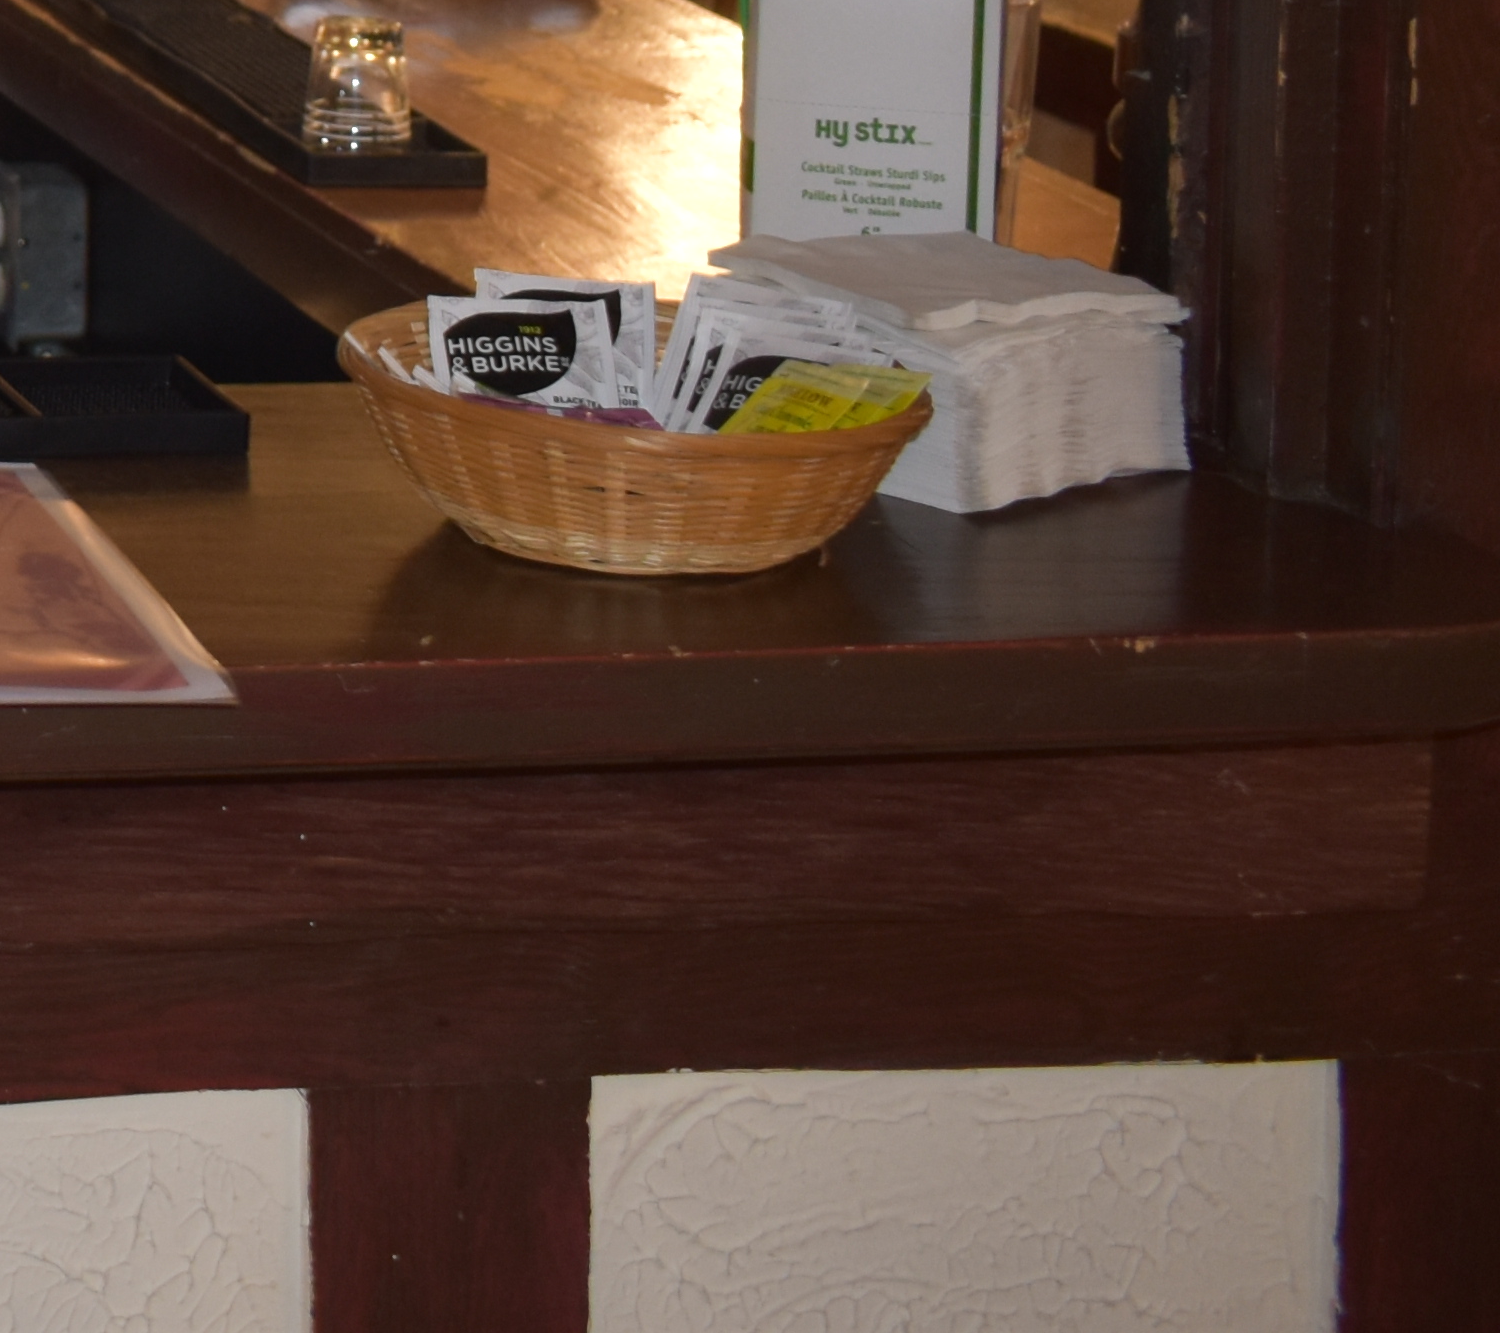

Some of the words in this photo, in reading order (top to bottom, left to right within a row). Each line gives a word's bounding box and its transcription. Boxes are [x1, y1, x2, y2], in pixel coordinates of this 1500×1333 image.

[801, 161, 845, 175] Cocktail
[848, 164, 883, 178] Straws
[922, 169, 946, 183] Sips
[851, 193, 895, 207] Cocktail
[448, 335, 557, 354] HIGGINS
